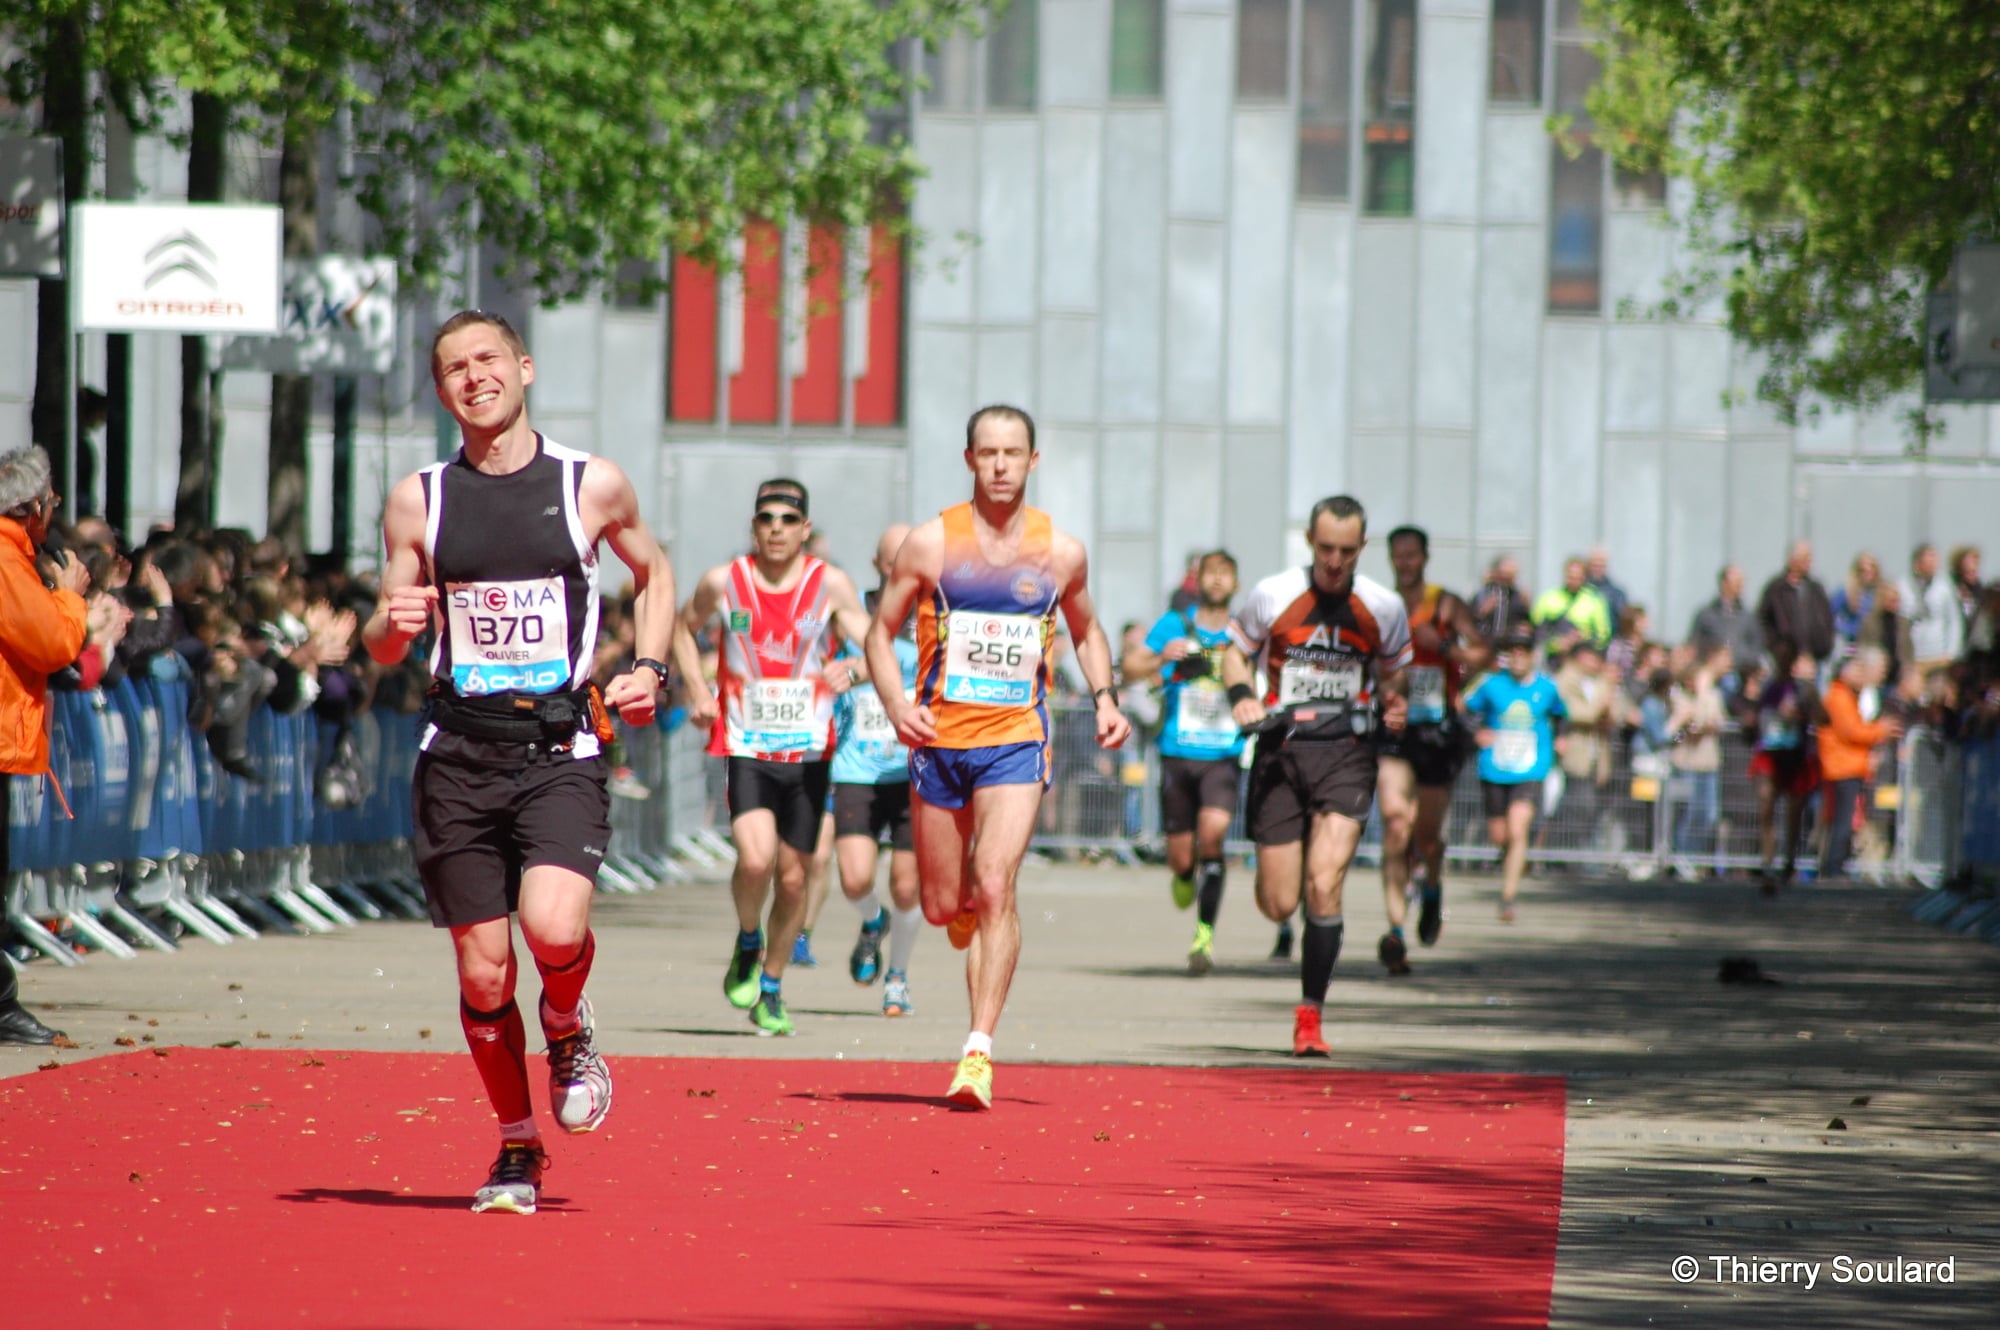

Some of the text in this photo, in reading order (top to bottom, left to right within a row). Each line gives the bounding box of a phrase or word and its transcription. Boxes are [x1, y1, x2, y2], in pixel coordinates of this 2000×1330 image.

[453, 586, 557, 612] SIGMA
[469, 615, 544, 646] 1370
[954, 618, 1035, 640] SIGMA
[1305, 622, 1353, 653] AL
[486, 650, 531, 661] OLIVIER
[967, 640, 1023, 667] 256
[489, 670, 559, 689] odlo
[975, 683, 1025, 700] odlo
[751, 701, 806, 721] 3382
